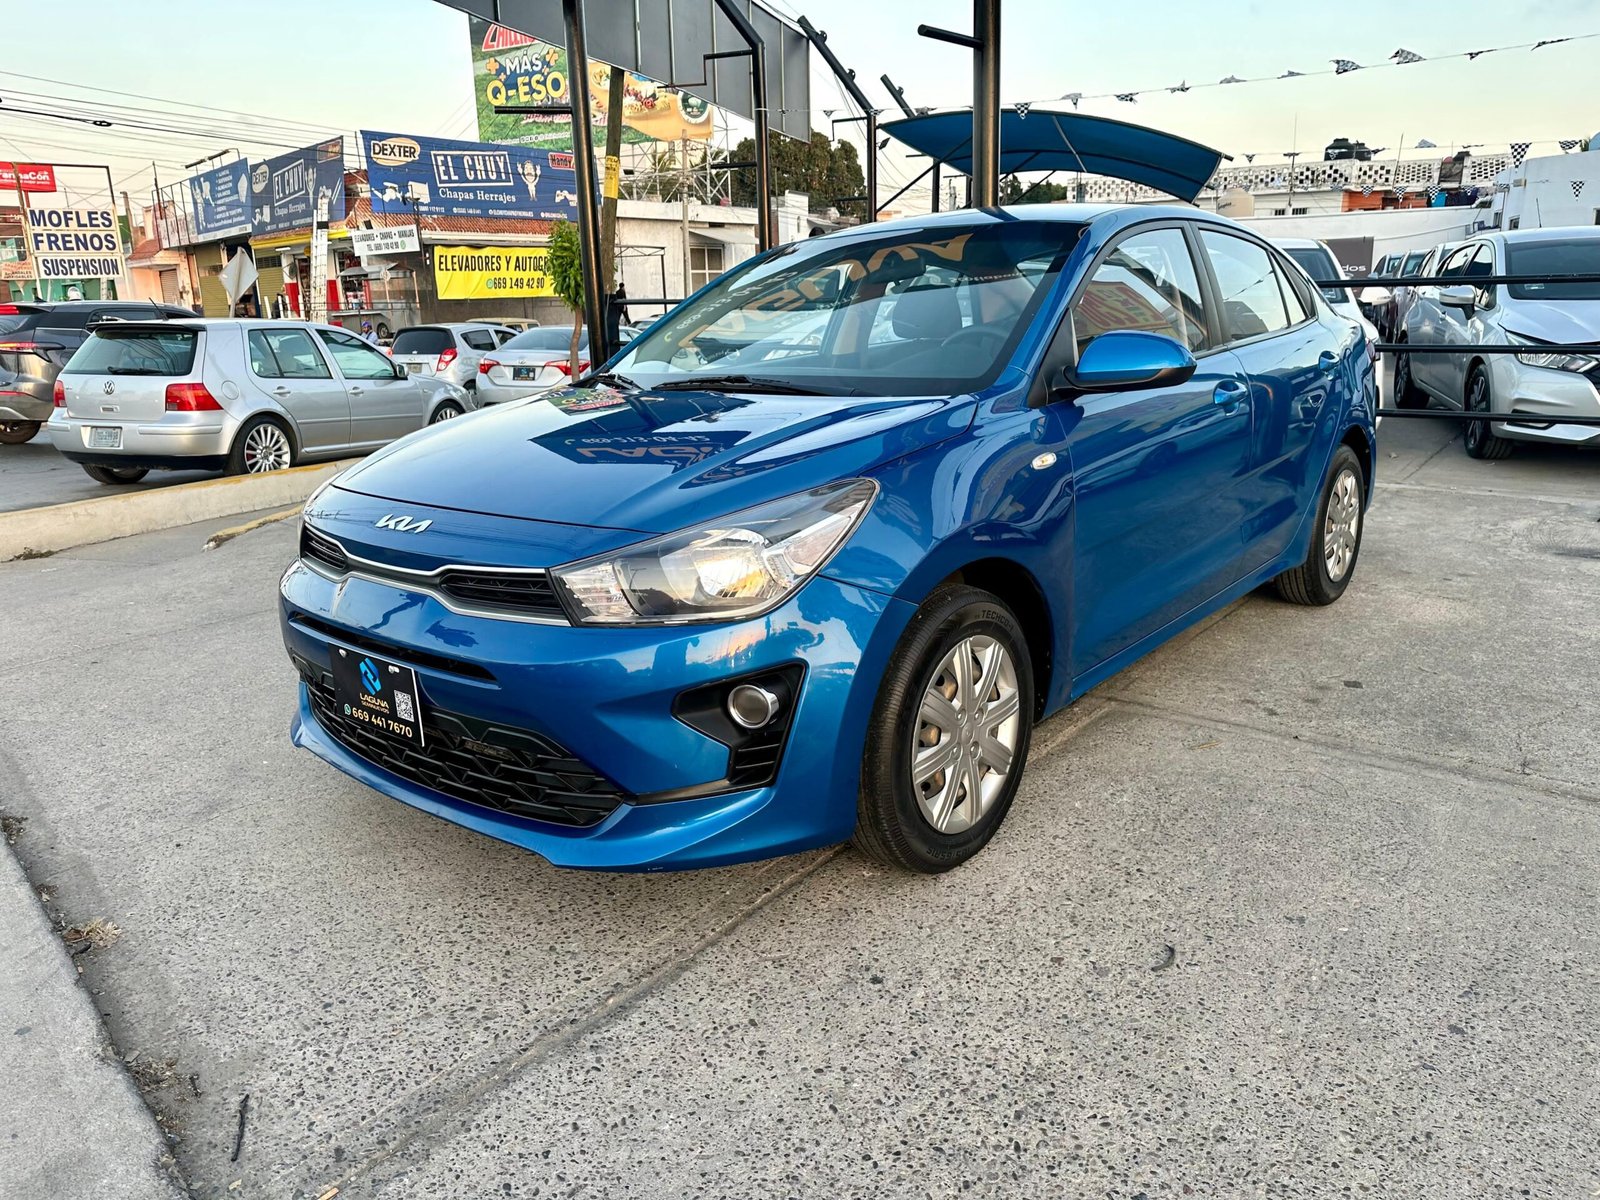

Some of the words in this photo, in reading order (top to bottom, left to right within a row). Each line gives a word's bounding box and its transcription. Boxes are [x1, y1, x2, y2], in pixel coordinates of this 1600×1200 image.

[505, 49, 542, 75] MÁS
[487, 72, 566, 105] Q-ESO
[372, 142, 417, 159] DEXTER
[436, 155, 459, 180] EL
[463, 155, 506, 180] CHUY
[275, 174, 283, 199] EL
[284, 164, 303, 194] CHUY
[439, 187, 474, 202] Chapas
[477, 190, 516, 203] Herrajes
[29, 209, 113, 228] MOFLES
[33, 232, 117, 251] FRENOS
[42, 258, 120, 276] SUSPENSION
[438, 255, 501, 272] ELEVADORES
[505, 256, 512, 272] Y
[493, 277, 507, 290] 669
[509, 277, 524, 290] 149
[526, 277, 535, 289] 42
[536, 277, 545, 289] 90
[374, 513, 433, 534] KIA
[360, 692, 390, 709] LAGUNA
[352, 707, 369, 722] 669
[371, 714, 386, 729] 441
[387, 720, 413, 738] 7670
